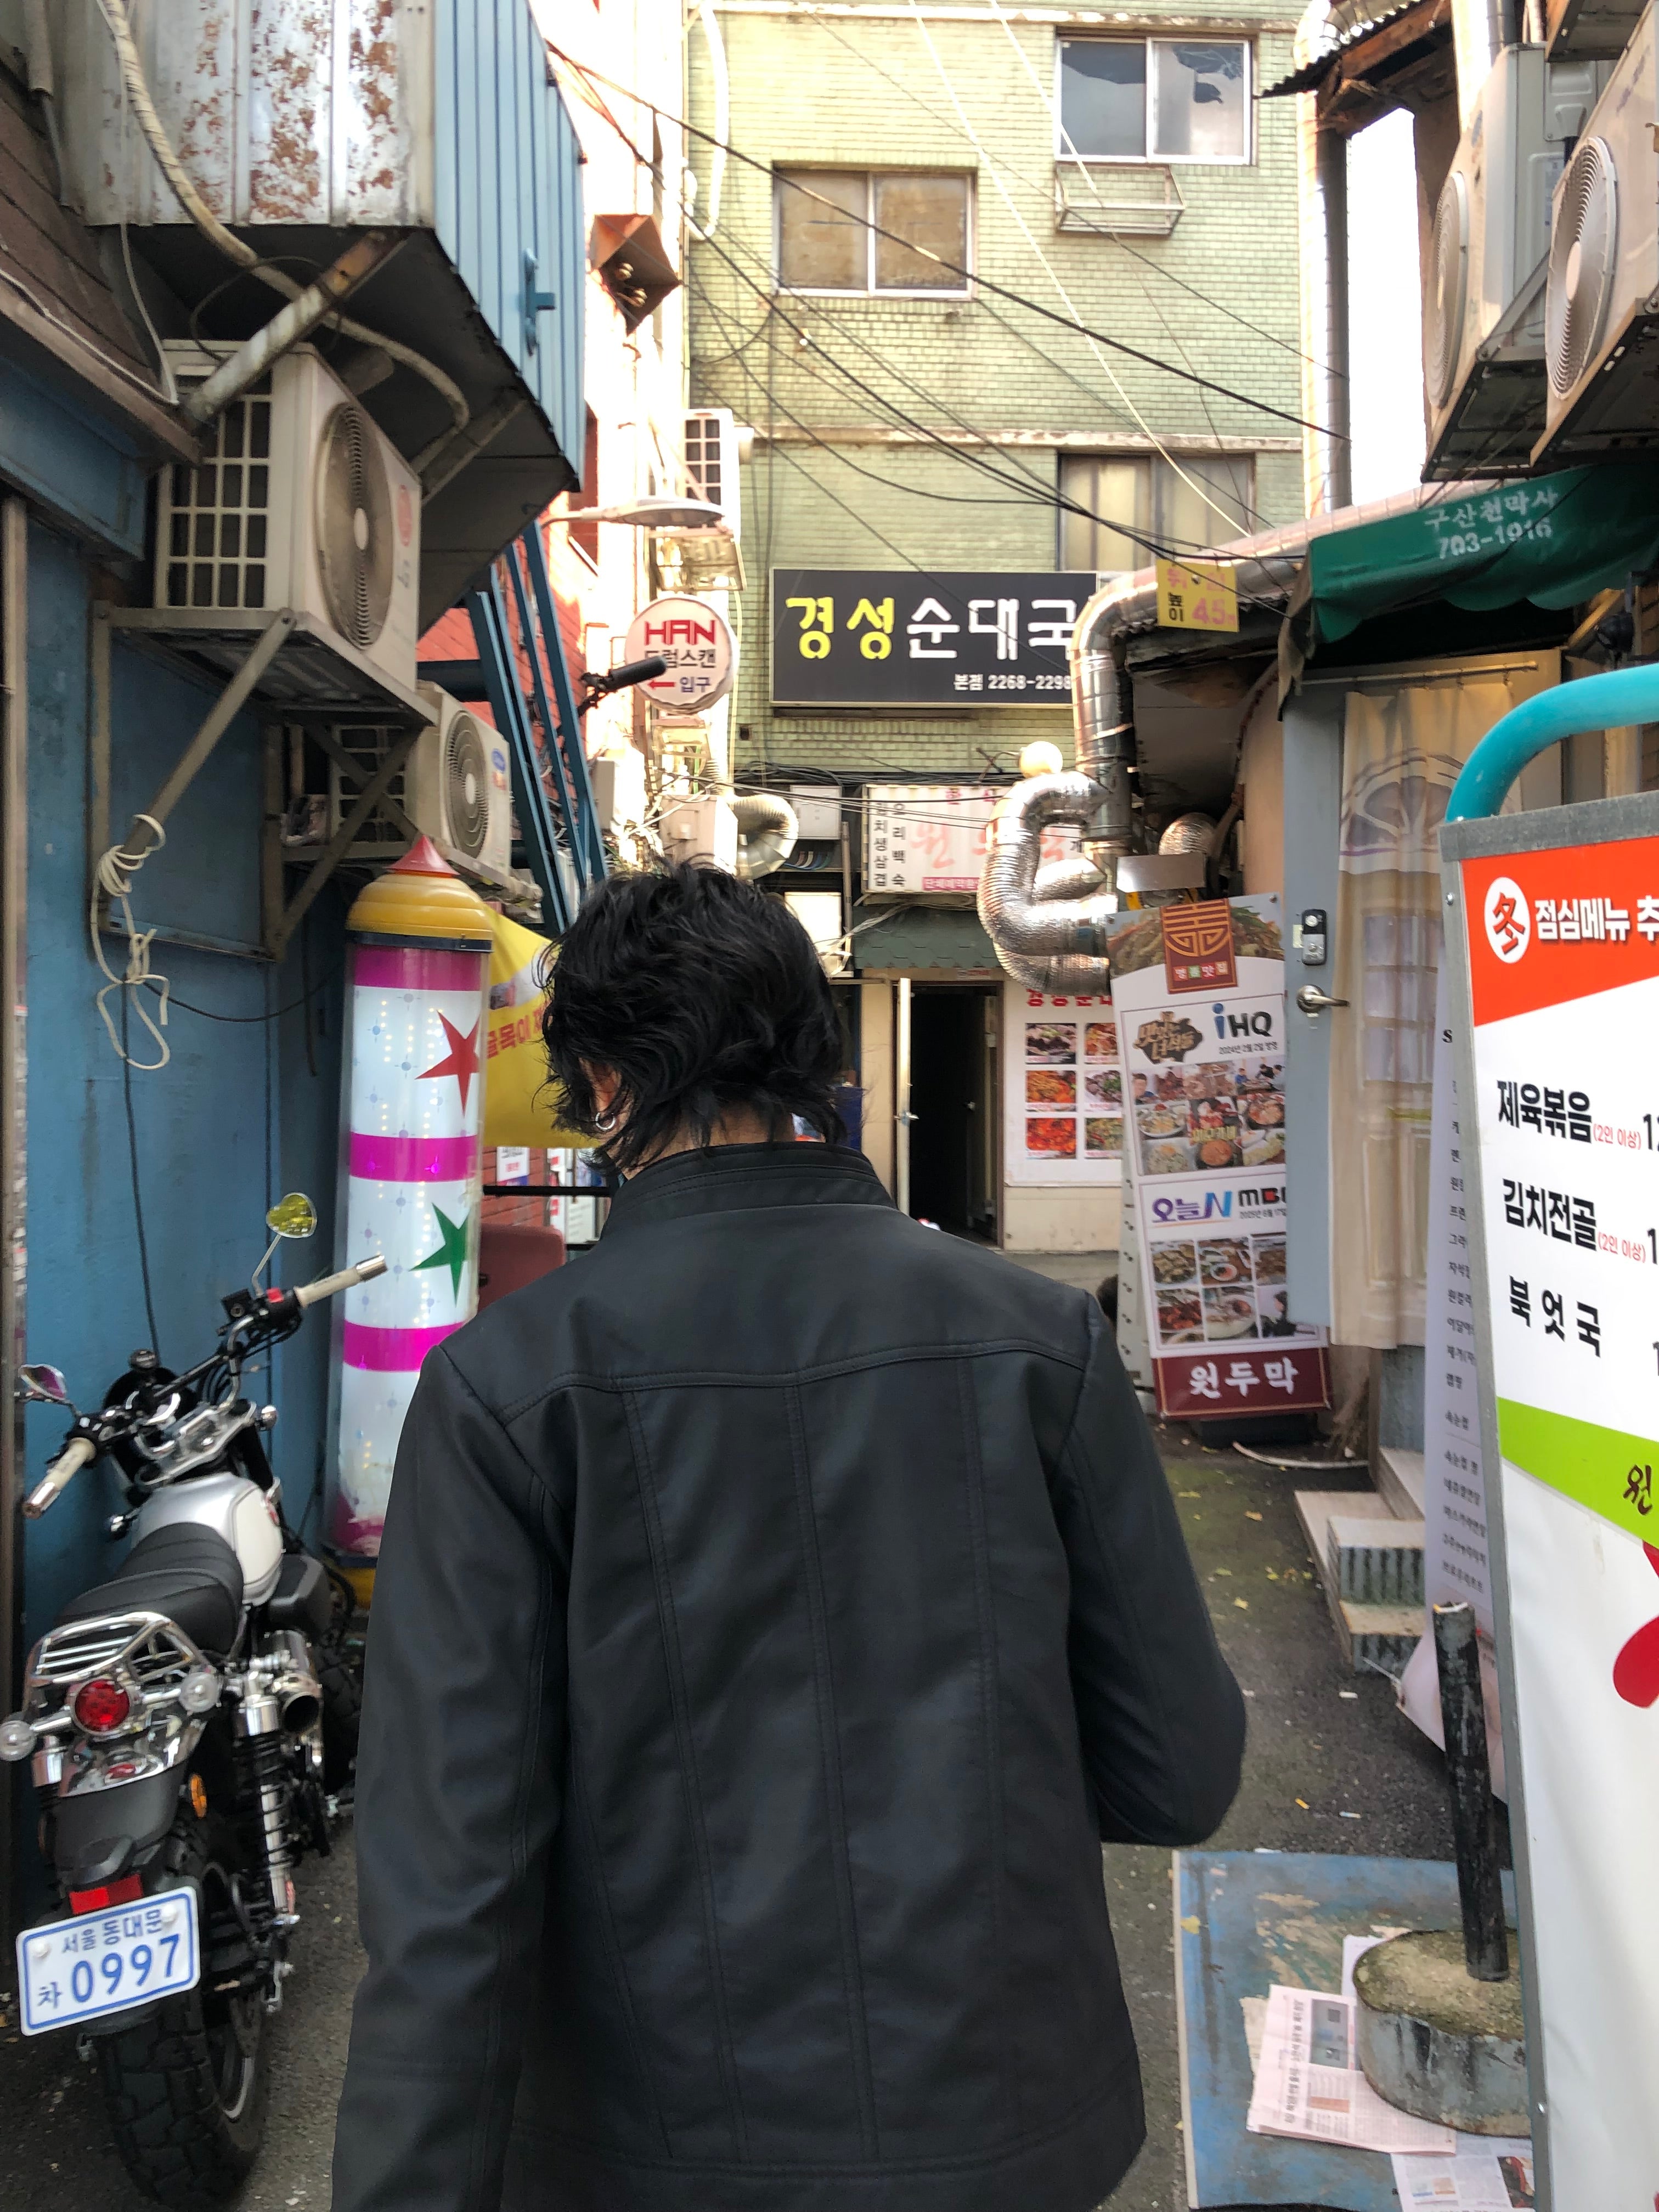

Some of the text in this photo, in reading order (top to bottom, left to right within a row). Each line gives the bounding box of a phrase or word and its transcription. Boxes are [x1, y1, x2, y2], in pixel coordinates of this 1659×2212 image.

[644, 619, 715, 645] HAN
[680, 676, 712, 693] 입구
[953, 674, 984, 691] 본점
[1534, 898, 1631, 941] 점심메뉴
[1212, 1003, 1273, 1040] iHQ
[1497, 1079, 1659, 1152] 제육볶음 (2인 이상) 1
[1503, 1178, 1597, 1252] 김치전골
[1598, 1231, 1618, 1255] (2인
[1622, 1239, 1646, 1263] 이상)
[1189, 1357, 1299, 1398] 원두막
[61, 1909, 163, 1954] 서울 동대문
[37, 1933, 179, 2010] 차 0997
